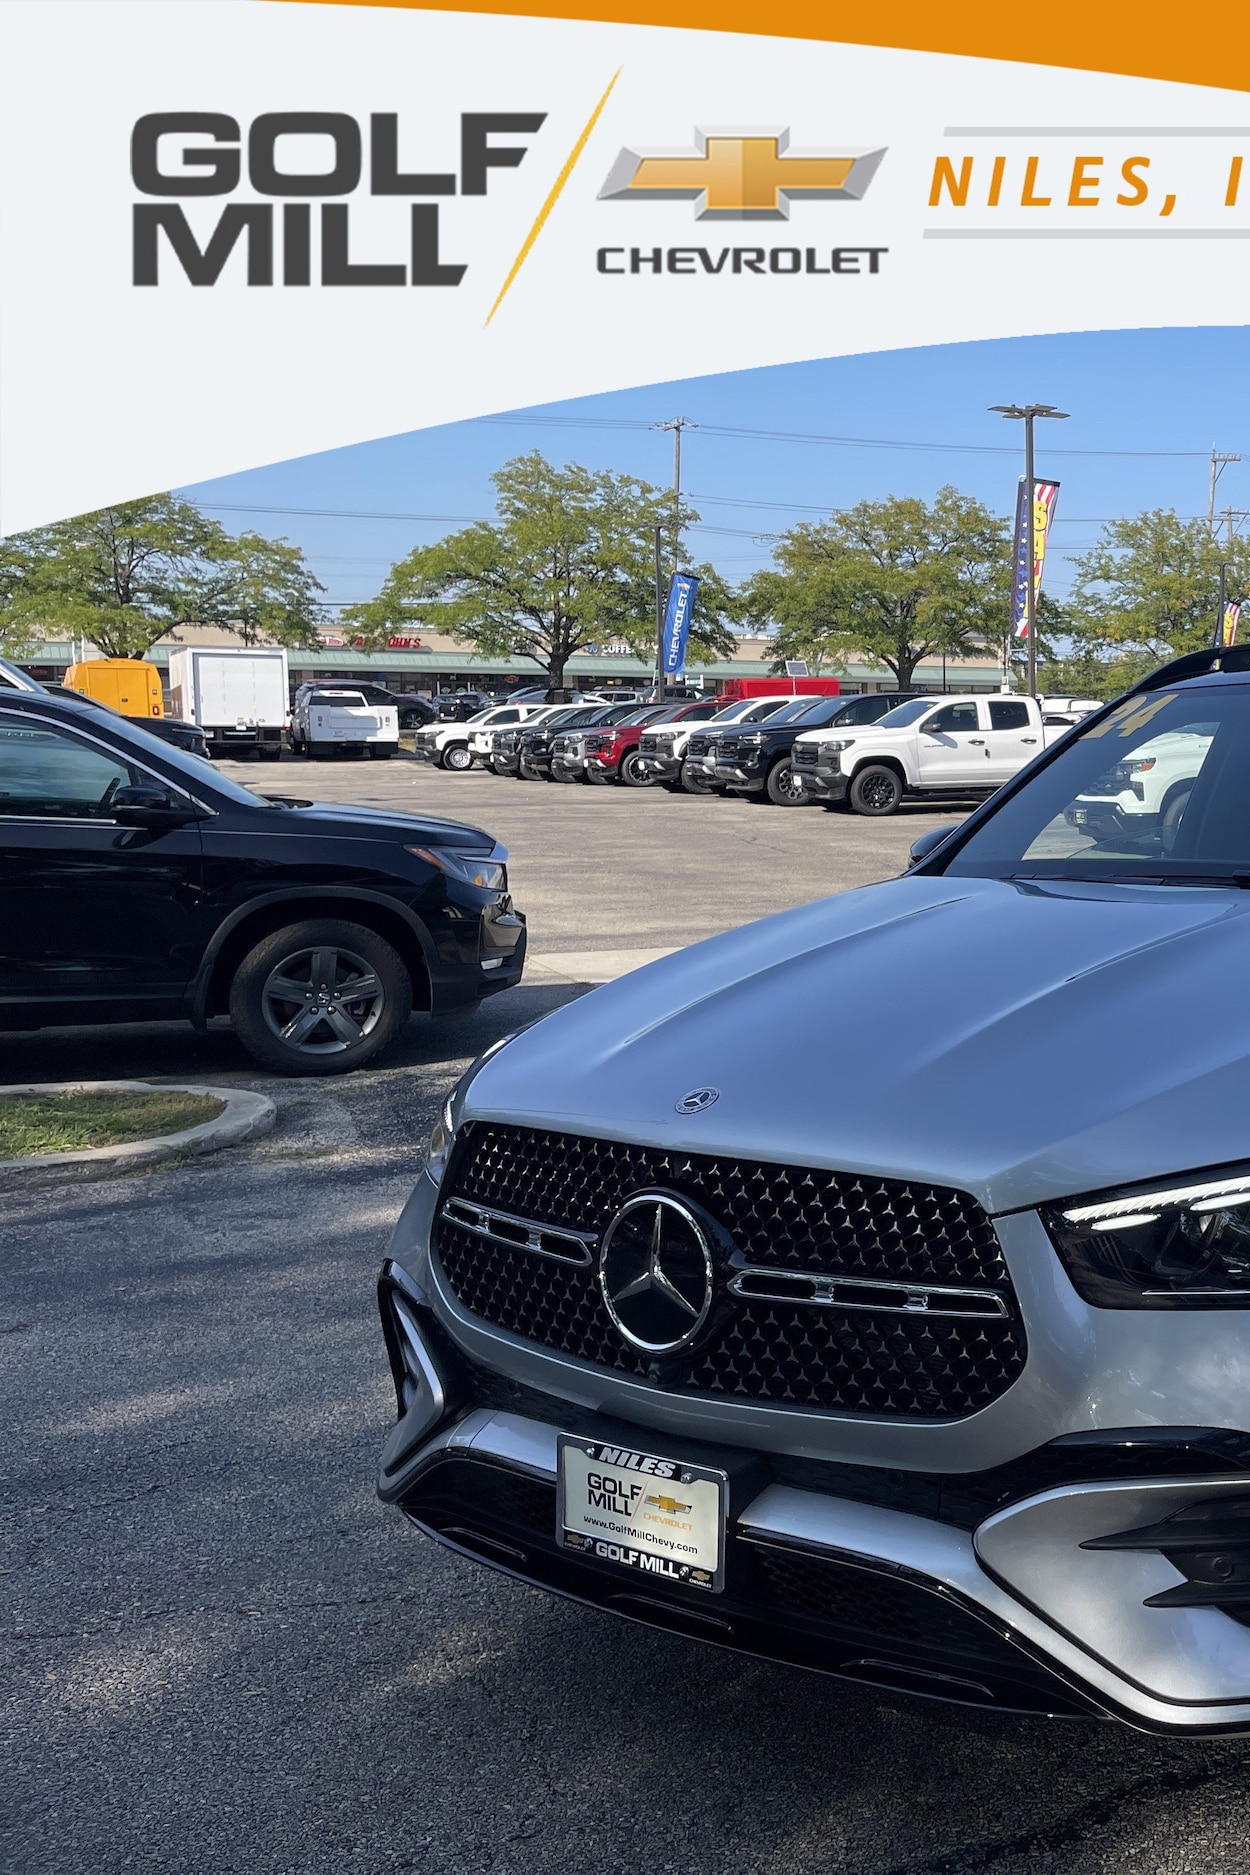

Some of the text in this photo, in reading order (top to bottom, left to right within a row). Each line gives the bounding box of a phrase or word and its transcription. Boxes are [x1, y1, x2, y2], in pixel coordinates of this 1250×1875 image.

[669, 591, 687, 666] CHEVROLET
[1078, 694, 1180, 740] 24
[599, 1447, 676, 1478] NILES
[588, 1472, 642, 1501] GOLF
[588, 1489, 632, 1517] MILL
[583, 1515, 698, 1555] www.GolfMillChevy.com
[643, 1512, 693, 1532] CHEVROLET
[595, 1541, 679, 1580] GOLF MILL
